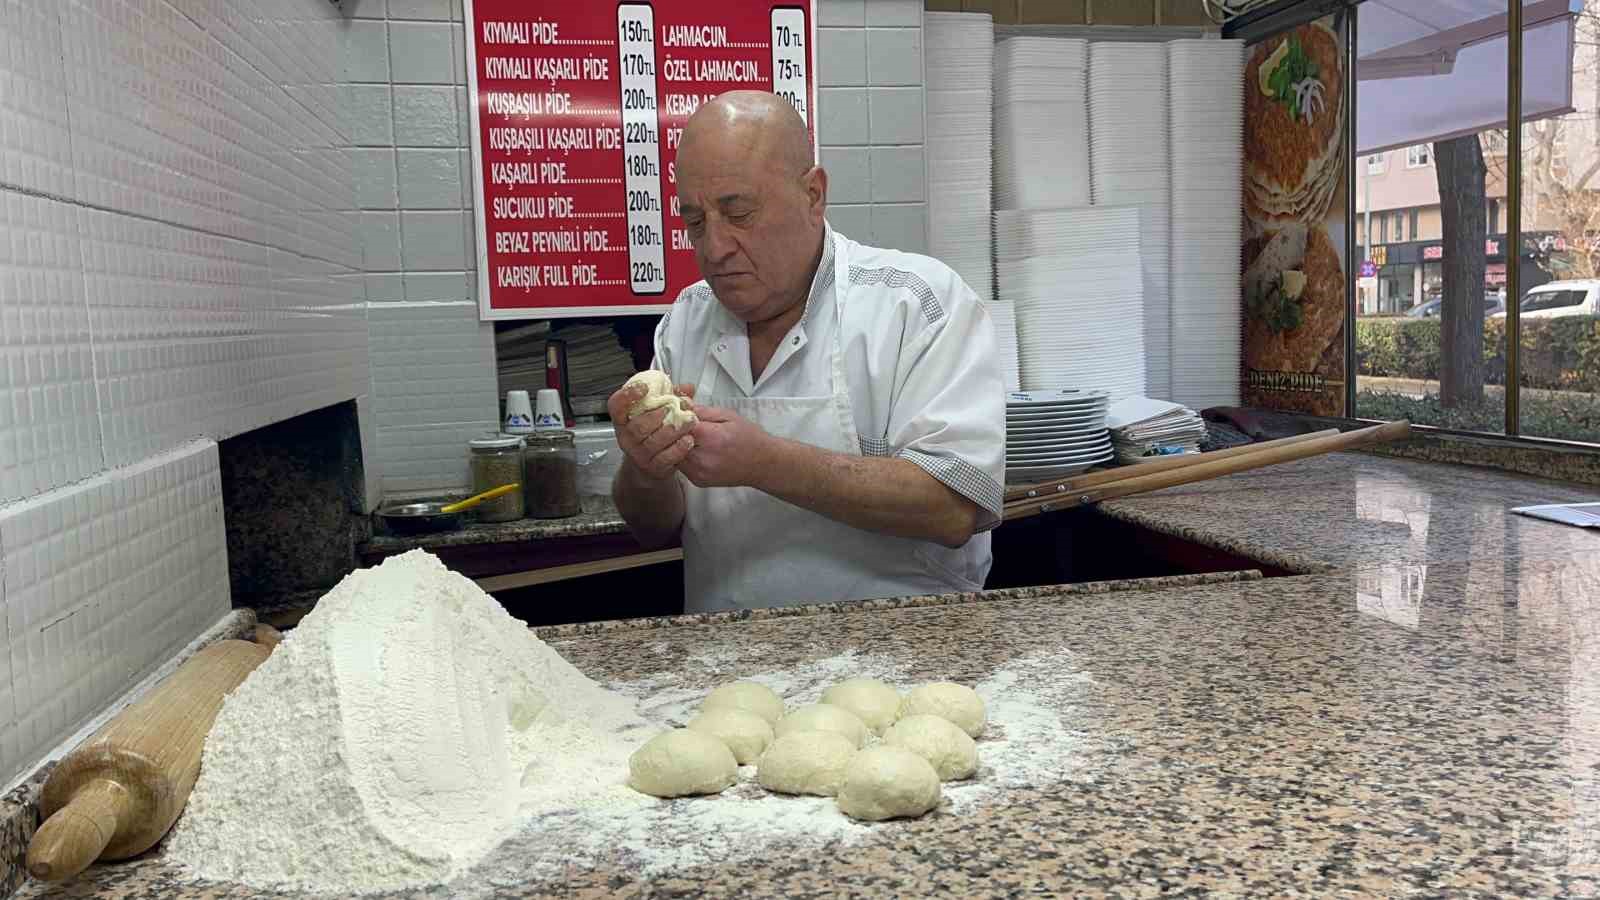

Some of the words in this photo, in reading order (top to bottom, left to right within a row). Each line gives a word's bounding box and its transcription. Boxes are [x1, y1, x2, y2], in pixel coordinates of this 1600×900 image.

[482, 21, 530, 45] KIYMALI
[485, 57, 532, 80] KIYMALI
[534, 57, 580, 85] KAŞARLI
[582, 52, 609, 80] PİDE
[663, 53, 693, 81] ÖZEL
[487, 92, 543, 120] KUŞBAŞILI
[665, 94, 700, 116] KEBAP
[489, 127, 544, 156] KUŞBAŞILI
[547, 127, 593, 156] KAŞARLI
[596, 123, 622, 150] PİDE
[491, 162, 538, 190] KAŞARLI
[493, 197, 545, 219] SUCUKLU
[495, 231, 530, 254] BEYAZ
[532, 225, 581, 254] PEYNİRLİ
[497, 267, 542, 293] KARIŞIK
[544, 265, 570, 288] FULL
